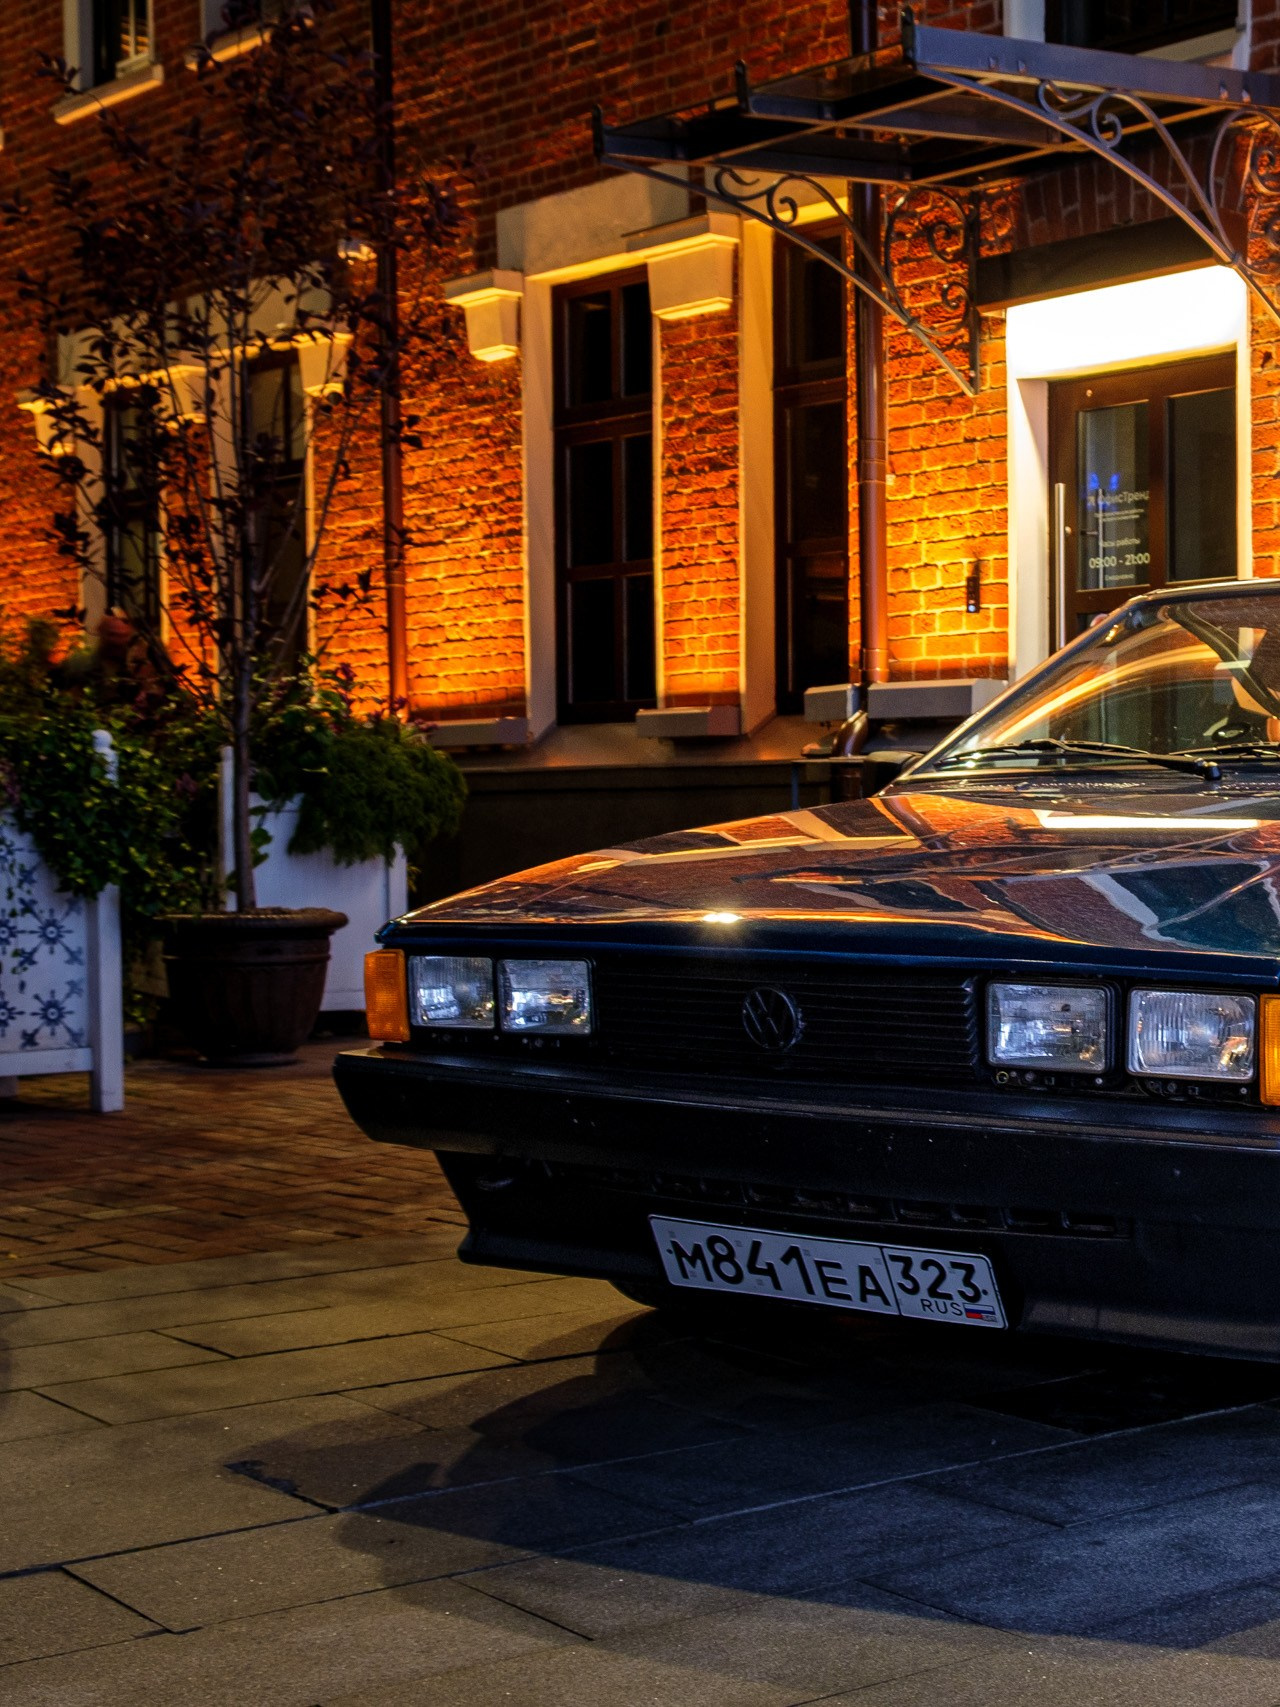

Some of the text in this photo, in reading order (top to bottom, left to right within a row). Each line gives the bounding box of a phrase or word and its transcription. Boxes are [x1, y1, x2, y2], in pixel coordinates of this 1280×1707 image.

[1089, 556, 1117, 569] 09:00
[1125, 553, 1150, 566] 21:00
[888, 1254, 982, 1303] 323
[920, 1299, 963, 1317] RUS
